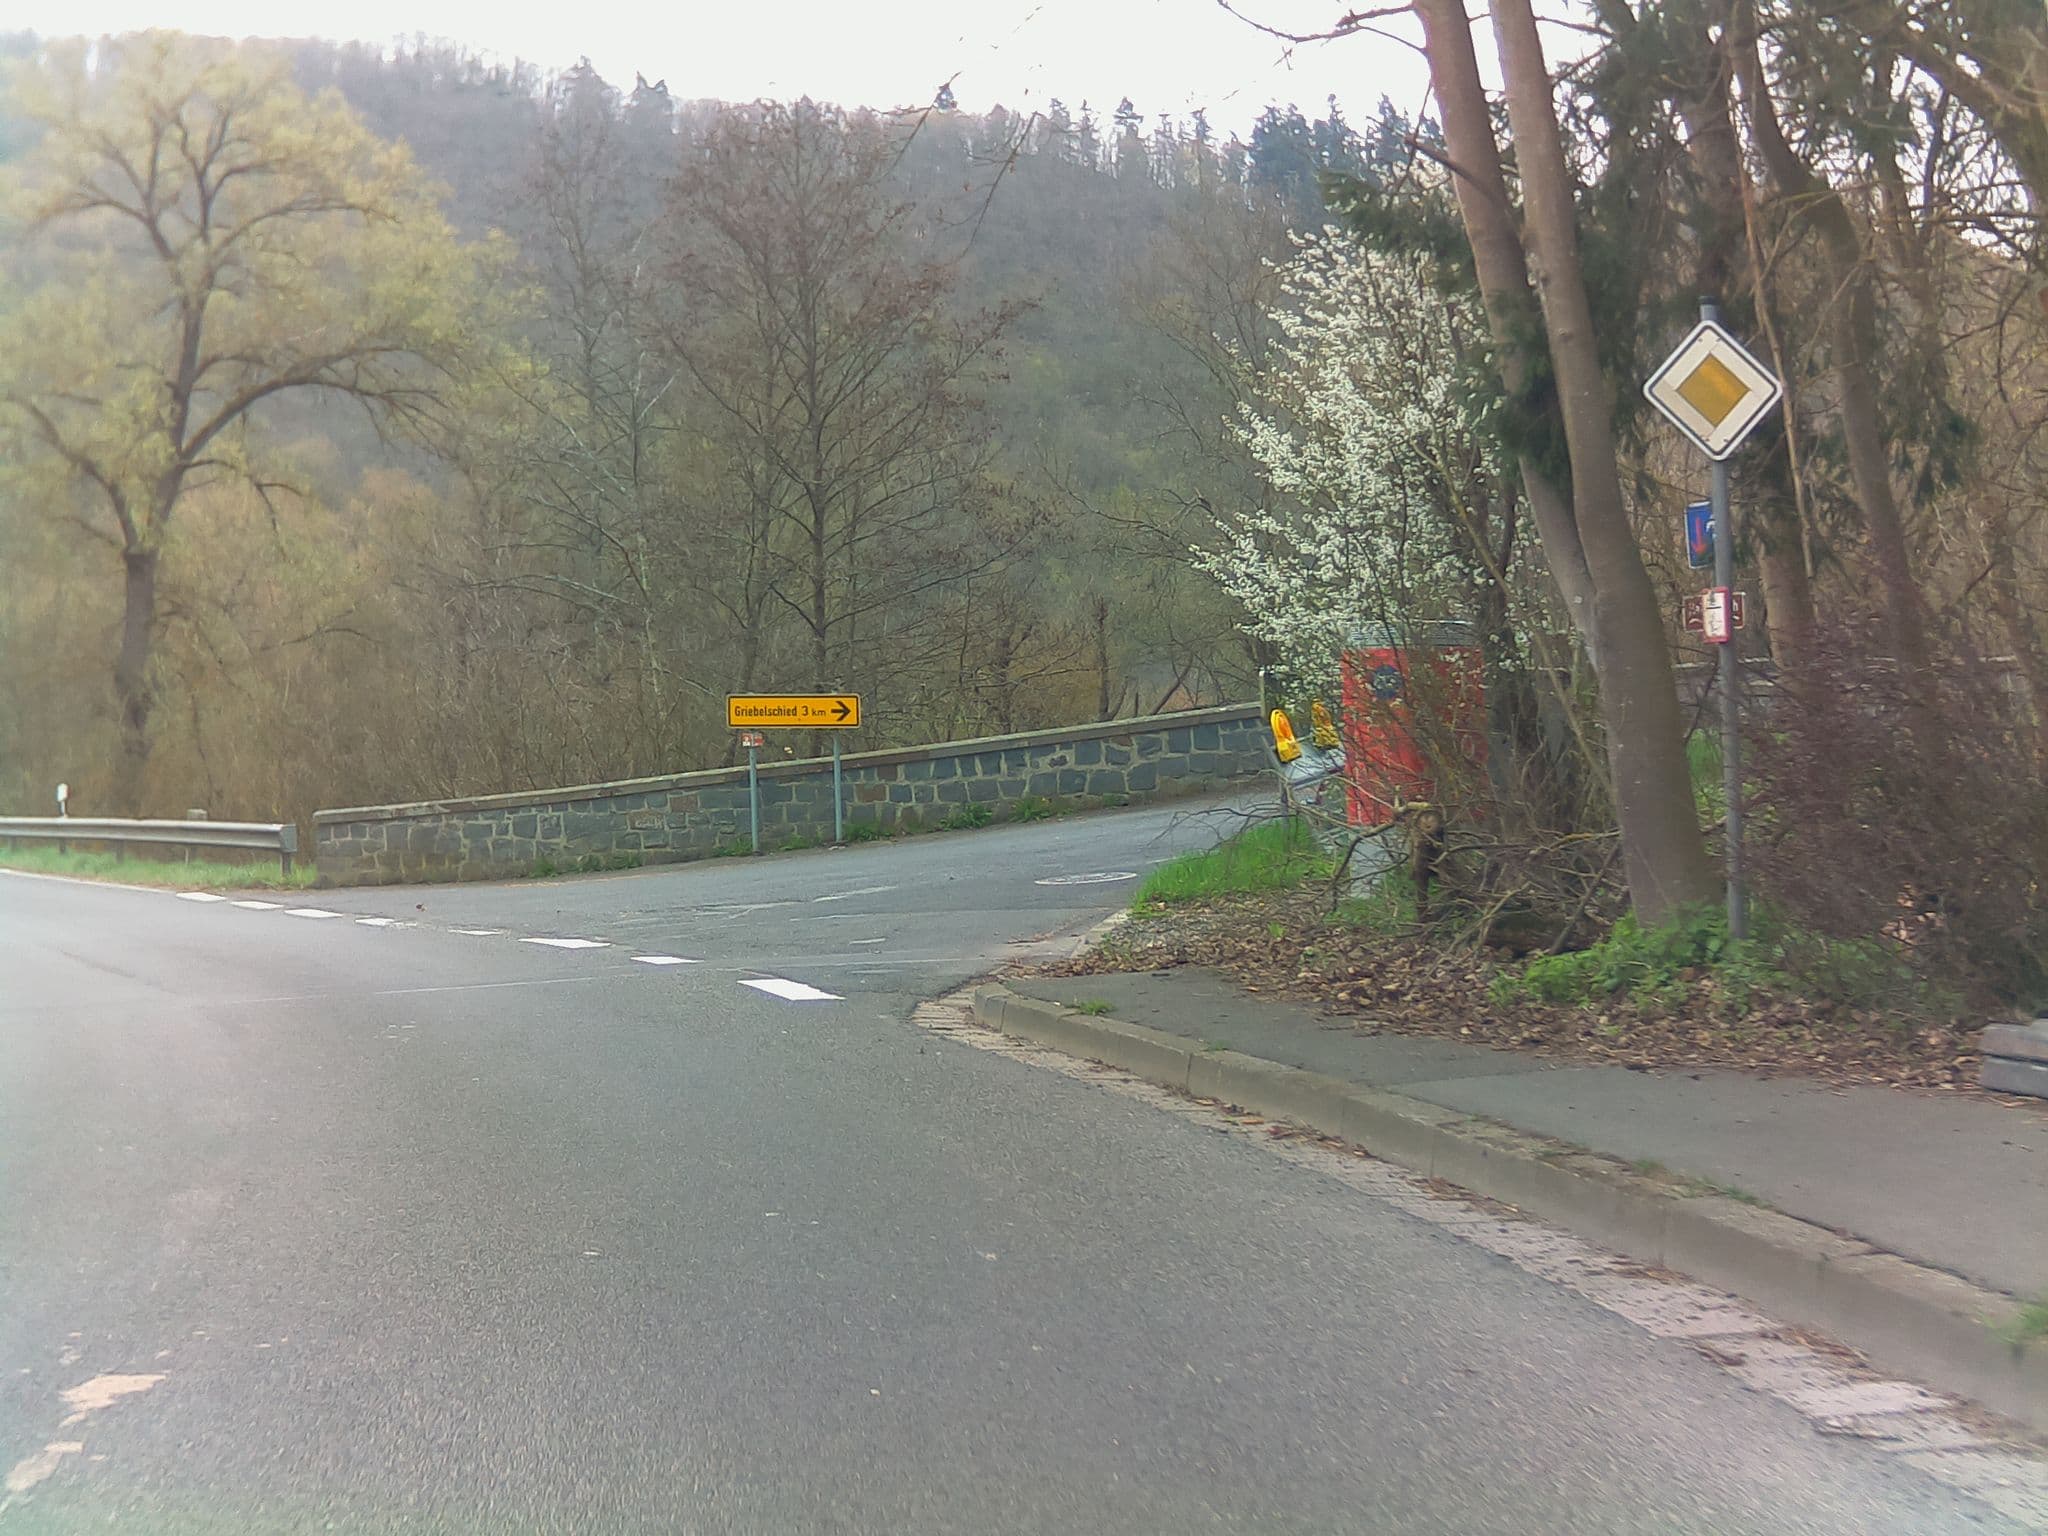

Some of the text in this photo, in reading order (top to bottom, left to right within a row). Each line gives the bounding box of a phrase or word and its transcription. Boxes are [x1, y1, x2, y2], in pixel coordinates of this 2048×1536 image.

[735, 705, 826, 717] Griebelschied 3 km
